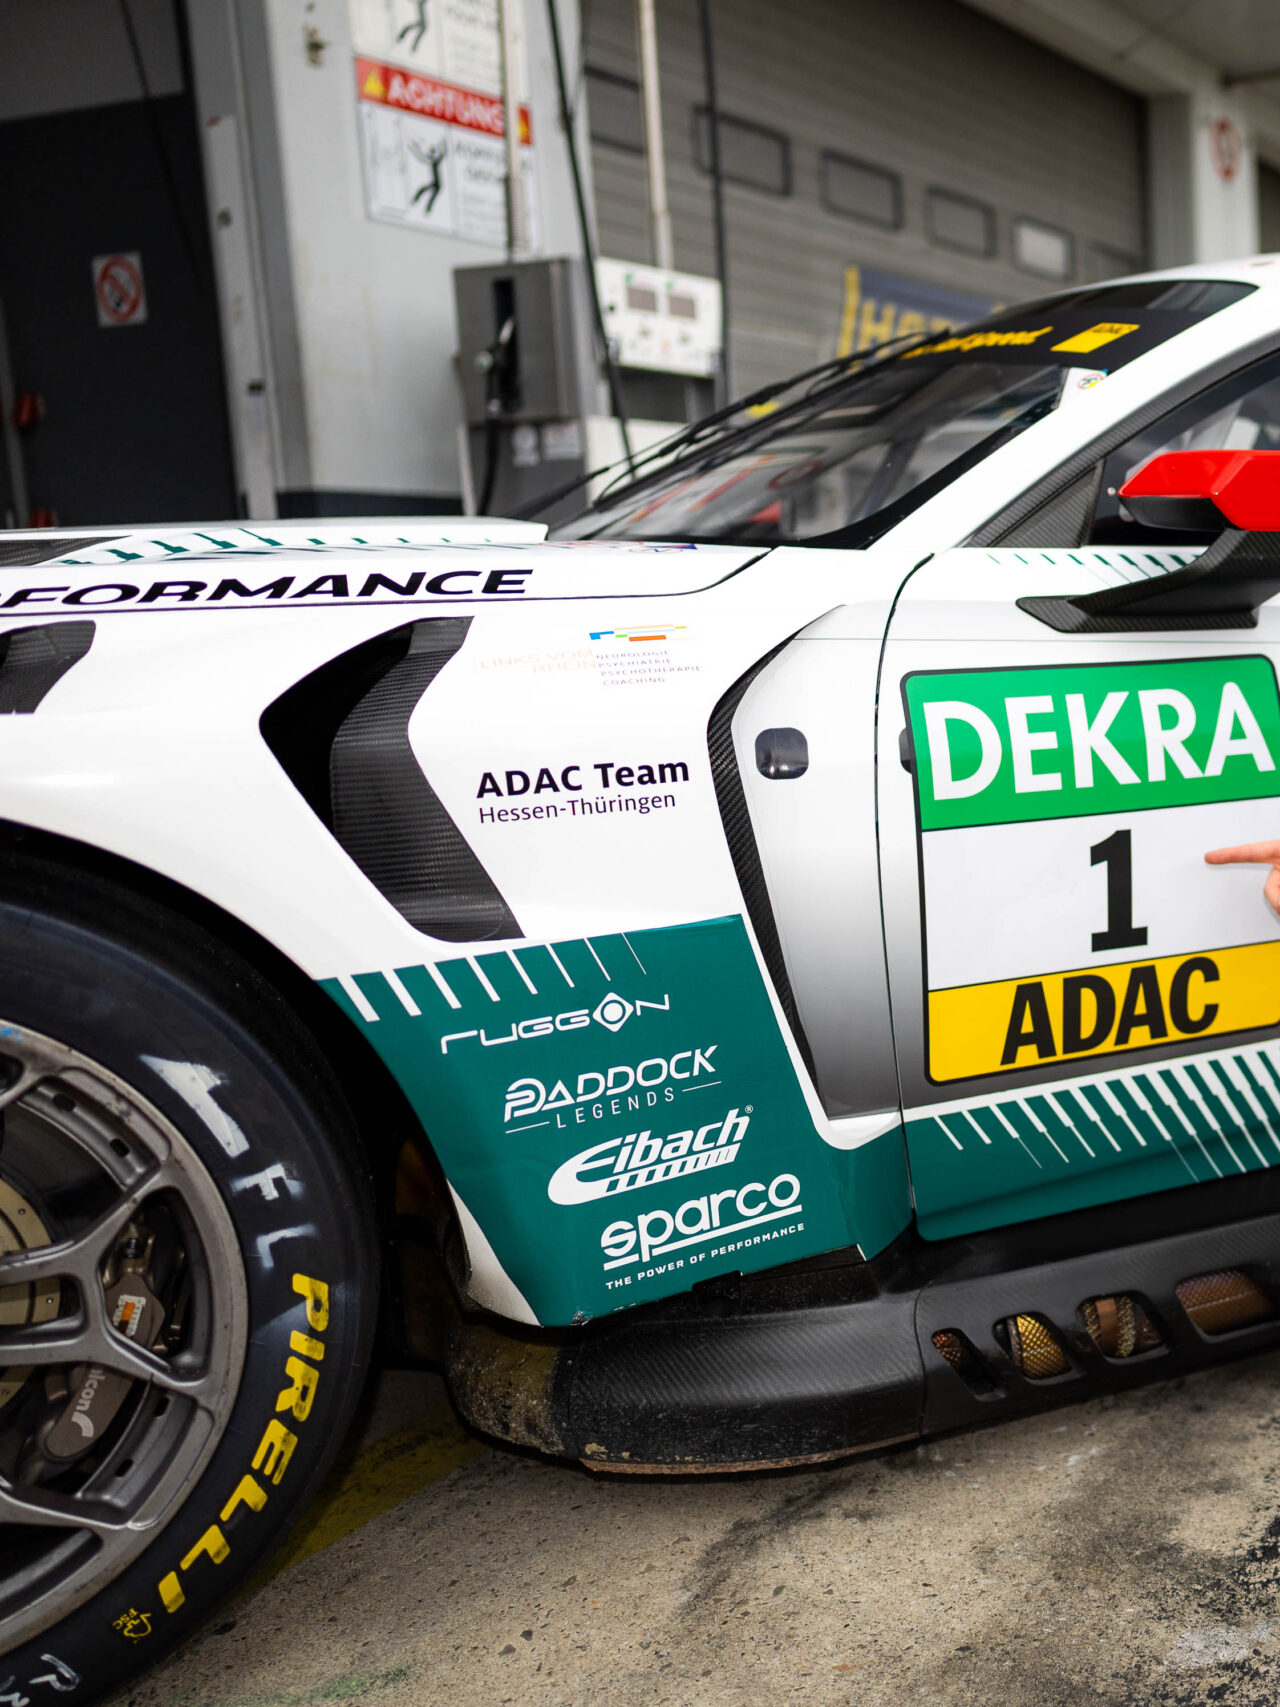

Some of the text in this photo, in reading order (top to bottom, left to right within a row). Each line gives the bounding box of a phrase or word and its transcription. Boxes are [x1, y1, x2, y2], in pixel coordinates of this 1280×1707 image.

[387, 74, 505, 132] ACHTUNG
[0, 569, 534, 608] FORMANCE
[602, 677, 666, 687] COACHING
[923, 681, 1276, 801] DEKRA
[476, 761, 690, 799] ADAC Team
[479, 794, 676, 824] Hessen-Thüringen
[1090, 829, 1149, 952] 1
[1000, 957, 1221, 1066] ADAC
[504, 1045, 718, 1123] PADDOCK
[557, 1087, 675, 1128] LEGENDS
[600, 1173, 802, 1264] sparco
[605, 1223, 805, 1290] THE POWER OF PERFORMANCE
[158, 1273, 329, 1614] PIRELLI
[112, 1607, 139, 1630] FSC
